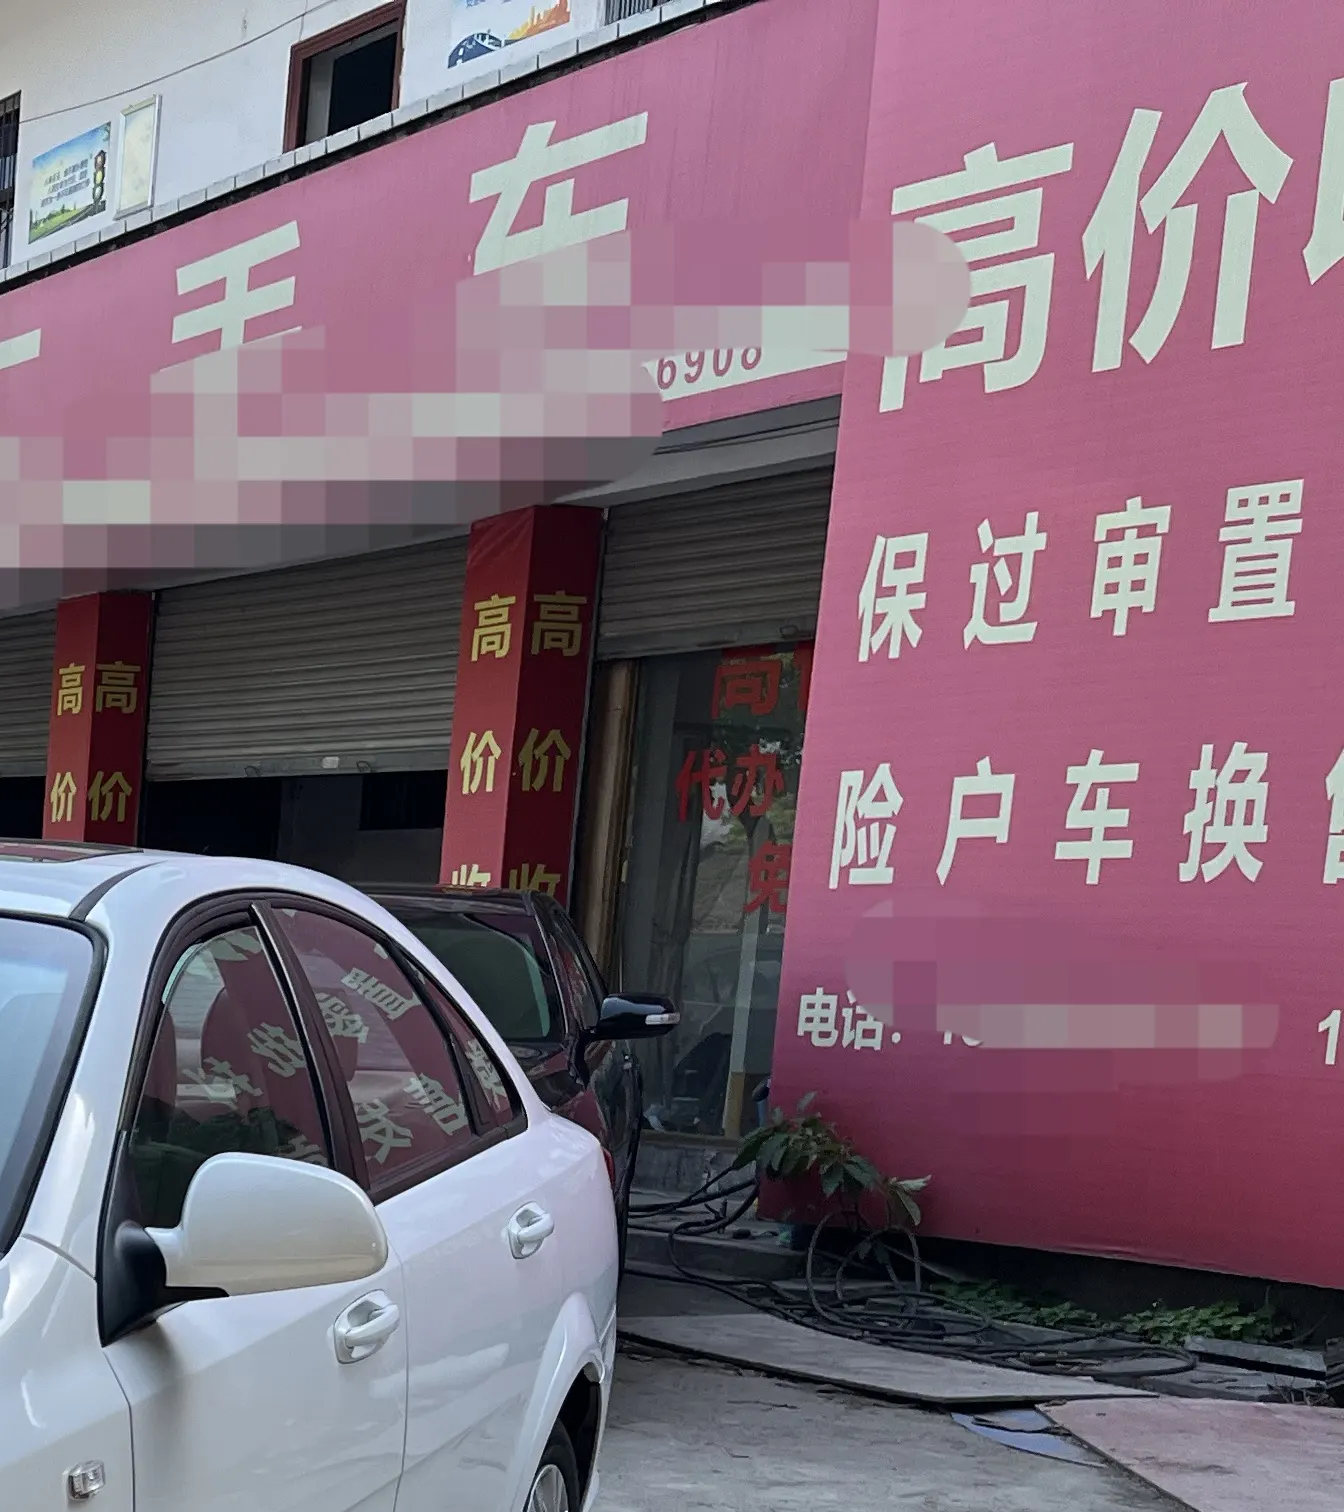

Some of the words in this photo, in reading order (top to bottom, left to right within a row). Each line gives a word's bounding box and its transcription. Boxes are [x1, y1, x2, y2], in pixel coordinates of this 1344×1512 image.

[879, 78, 1344, 413] 高价
[50, 662, 86, 823] 高价
[88, 660, 142, 823] 高价
